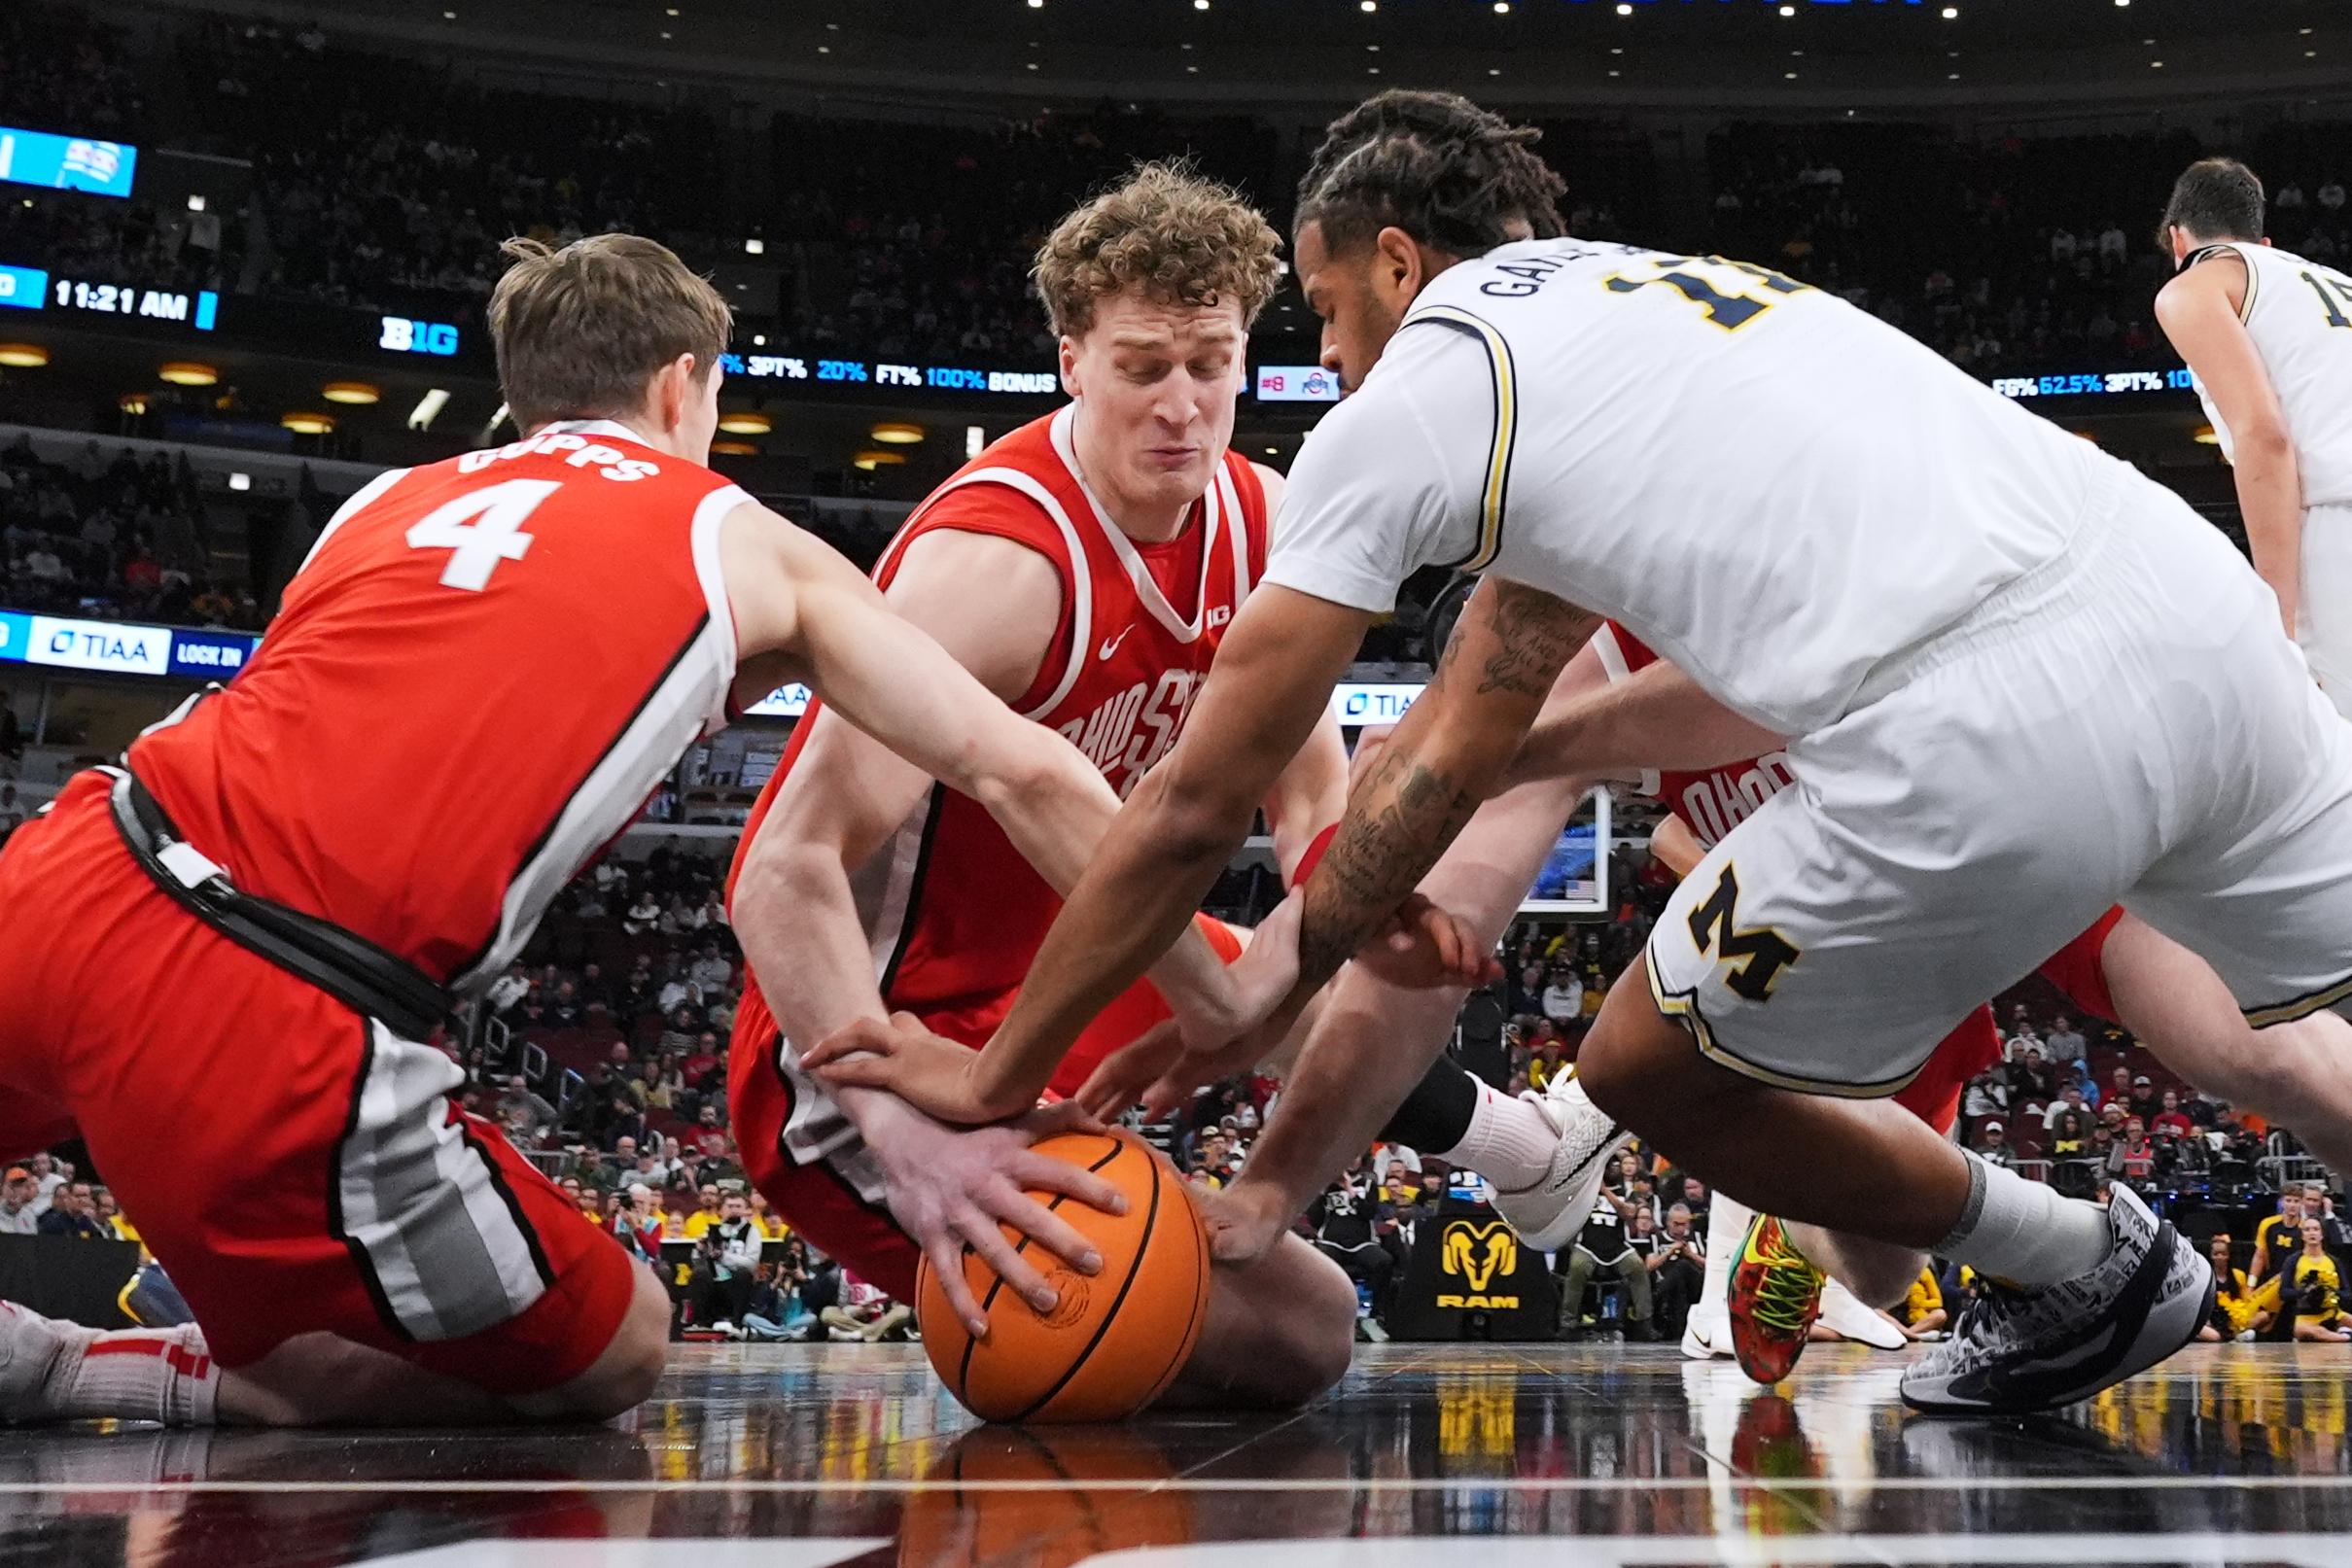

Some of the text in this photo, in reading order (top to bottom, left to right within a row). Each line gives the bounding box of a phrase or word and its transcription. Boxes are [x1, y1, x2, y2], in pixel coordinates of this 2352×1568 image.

[55, 280, 189, 321] 11:21 AM
[747, 355, 808, 379] 3PT%
[817, 360, 868, 382] 20%
[875, 364, 922, 387] FT%
[927, 366, 986, 390] 100%
[988, 371, 1057, 394] BONUS
[2039, 374, 2103, 395] 62.5%
[2104, 371, 2163, 393] 3PT%
[404, 478, 565, 592] 4
[82, 634, 149, 662] TIAA
[177, 643, 242, 667] LOCK IN
[1374, 694, 1412, 716] TIA
[1687, 859, 1802, 1003] M
[1436, 1295, 1520, 1309] RAM
